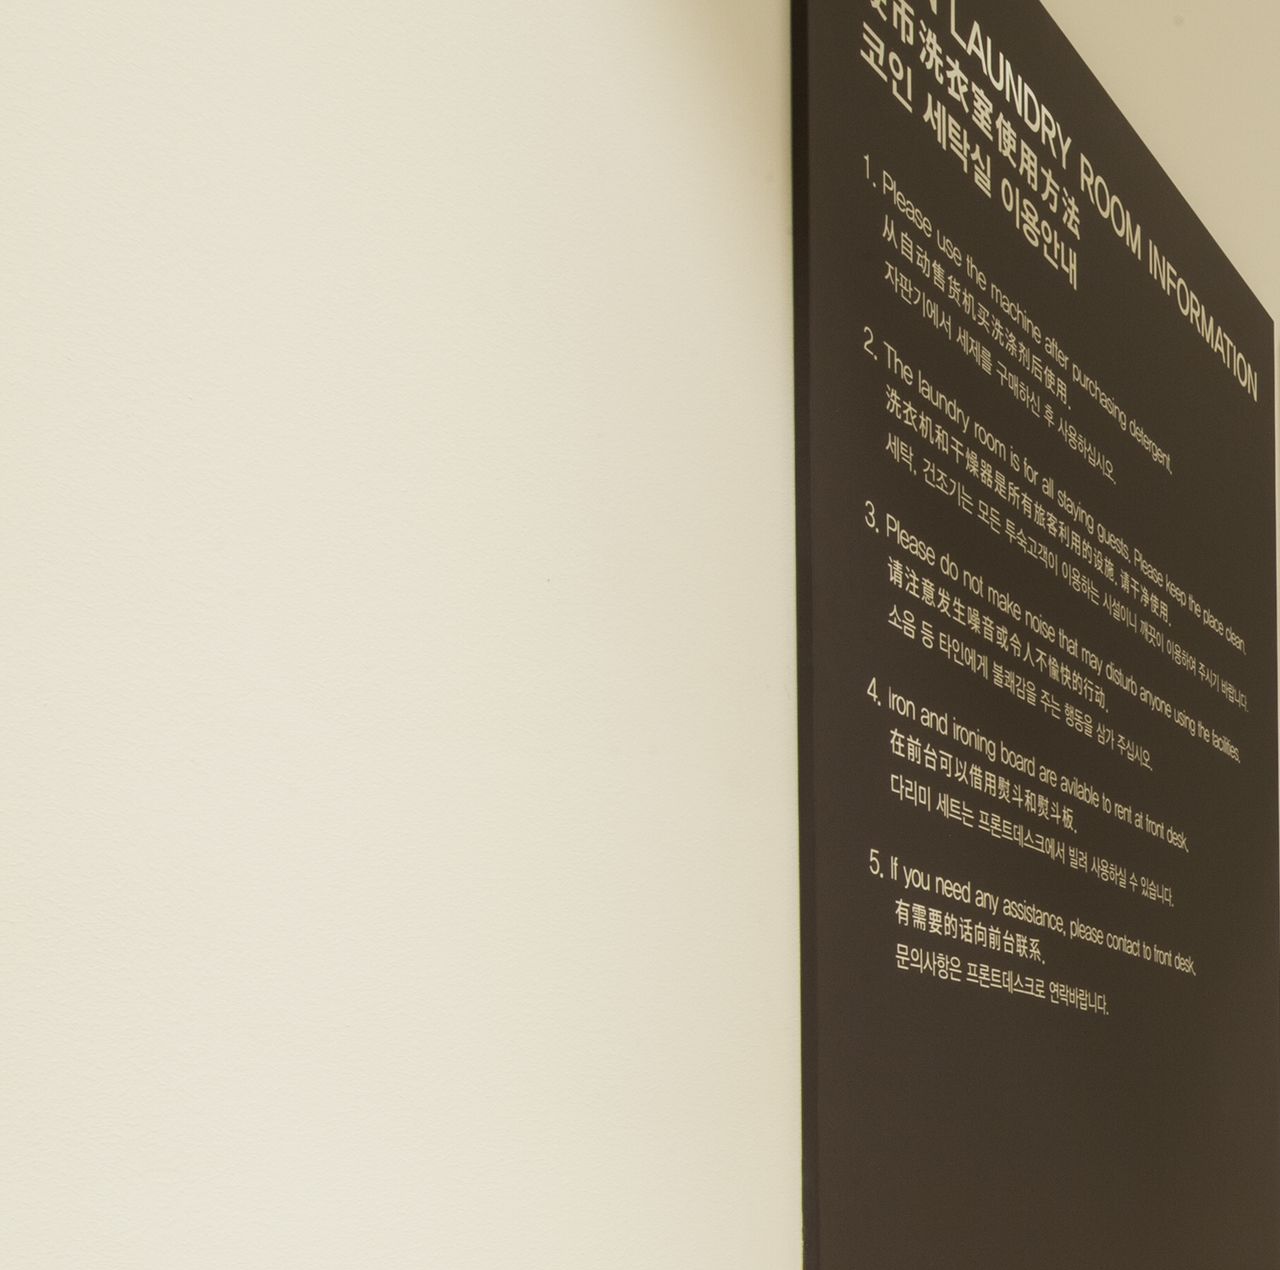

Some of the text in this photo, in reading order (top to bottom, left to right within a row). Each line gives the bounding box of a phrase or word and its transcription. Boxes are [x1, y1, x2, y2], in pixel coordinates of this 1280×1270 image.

[860, 22, 1077, 290] 코인 세탁실 이용안내
[950, 0, 1257, 402] LAUNDRY ROOM INFORMATION
[864, 154, 1172, 475] 1. Please use the machine after purchasing detergent.
[884, 261, 1116, 485] 자판기에서 세제를 구매하신 후 사용하십시오.
[863, 326, 878, 361] 2.
[883, 341, 913, 386] The
[918, 370, 970, 434] laundry
[974, 422, 1006, 461] room
[1010, 445, 1020, 472] is
[1023, 457, 1039, 485] for
[1042, 477, 1054, 500] all
[1057, 490, 1094, 535] staying
[1097, 523, 1131, 564] guests.
[1134, 548, 1164, 587] Please
[1165, 574, 1187, 607] keep
[1188, 594, 1201, 618] the
[1203, 609, 1224, 636] place
[923, 458, 974, 515] 건조기는
[977, 500, 1001, 534] 모든
[1005, 518, 1058, 576] 투숙고객이
[1061, 561, 1100, 606] 이용하는
[1102, 592, 1137, 633] 시설이니
[1166, 639, 1196, 676] 이용하여
[1198, 662, 1219, 692] 주시기
[865, 500, 879, 533] 3.
[886, 513, 936, 566] Please
[940, 553, 959, 581] do
[963, 570, 984, 598] not
[988, 586, 1021, 621] make
[1025, 610, 1056, 643] noise
[1058, 628, 1078, 658] that
[1081, 647, 1103, 676] may
[1105, 661, 1138, 696] disturb
[1139, 686, 1172, 718] anyone
[1174, 709, 1196, 737] using
[1197, 721, 1210, 743] the
[888, 604, 1153, 771] 소음 등 타인에게 불쾌감을 주는 행동을 삼가 주십시오.
[867, 677, 1189, 853] 4. Iron and ironing board are avilable to rent at front desk.
[890, 774, 1174, 907] 다리미 세트는 프론트데스크에서 빌려 사용하실 수 있습니다.
[869, 848, 1196, 976] 5. If you need any assistance, please contact to front desk.
[895, 943, 1109, 1015] 문의사항은 프론트데스크로 연락바랍니다.
